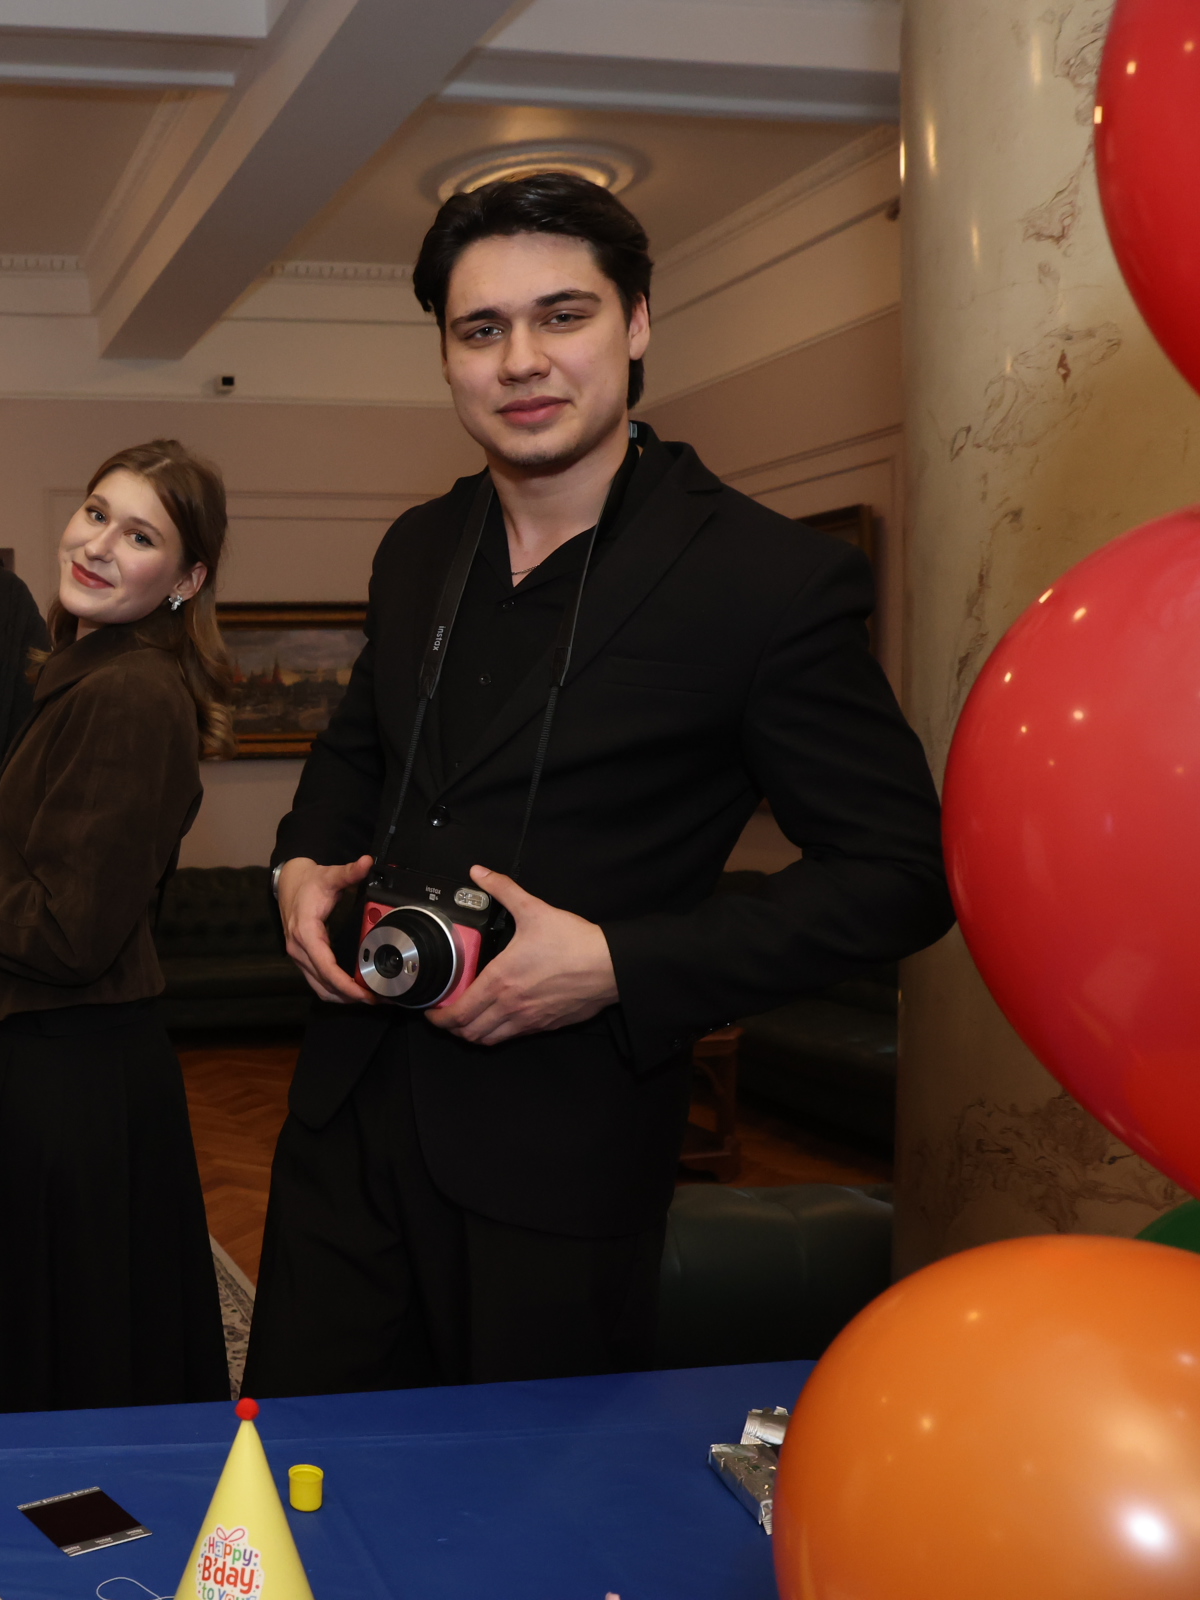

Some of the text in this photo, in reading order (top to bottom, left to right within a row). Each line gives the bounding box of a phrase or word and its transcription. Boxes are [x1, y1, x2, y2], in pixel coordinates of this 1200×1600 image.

[432, 625, 447, 651] instax
[208, 1536, 253, 1567] Happy
[202, 1555, 255, 1594] B'day
